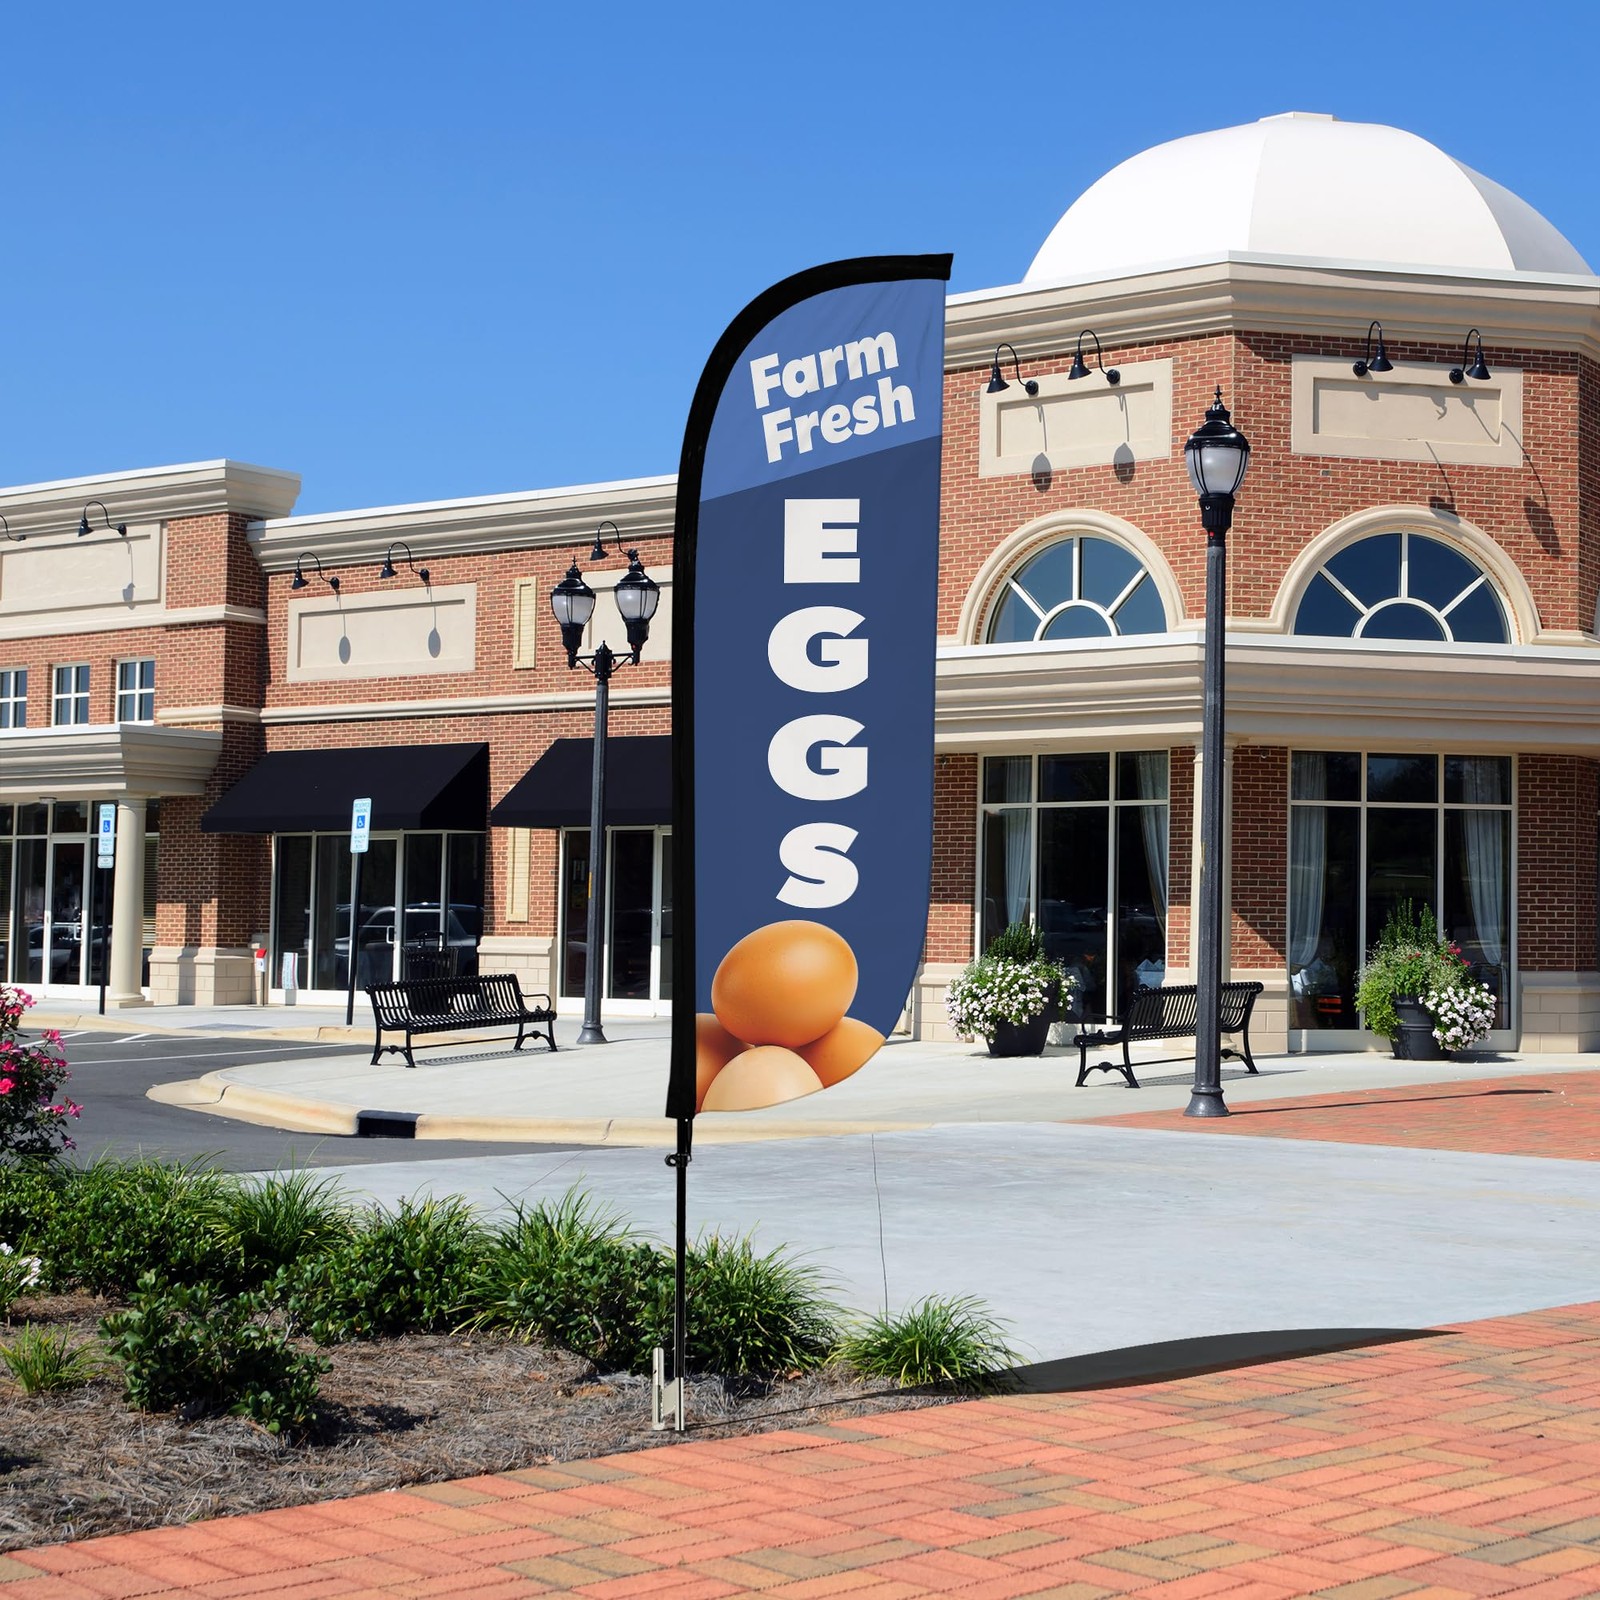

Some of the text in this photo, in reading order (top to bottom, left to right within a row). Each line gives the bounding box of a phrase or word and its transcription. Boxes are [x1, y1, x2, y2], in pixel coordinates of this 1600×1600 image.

[750, 331, 899, 409] Farm
[762, 376, 916, 464] Fresh
[767, 498, 869, 909] EGGS
